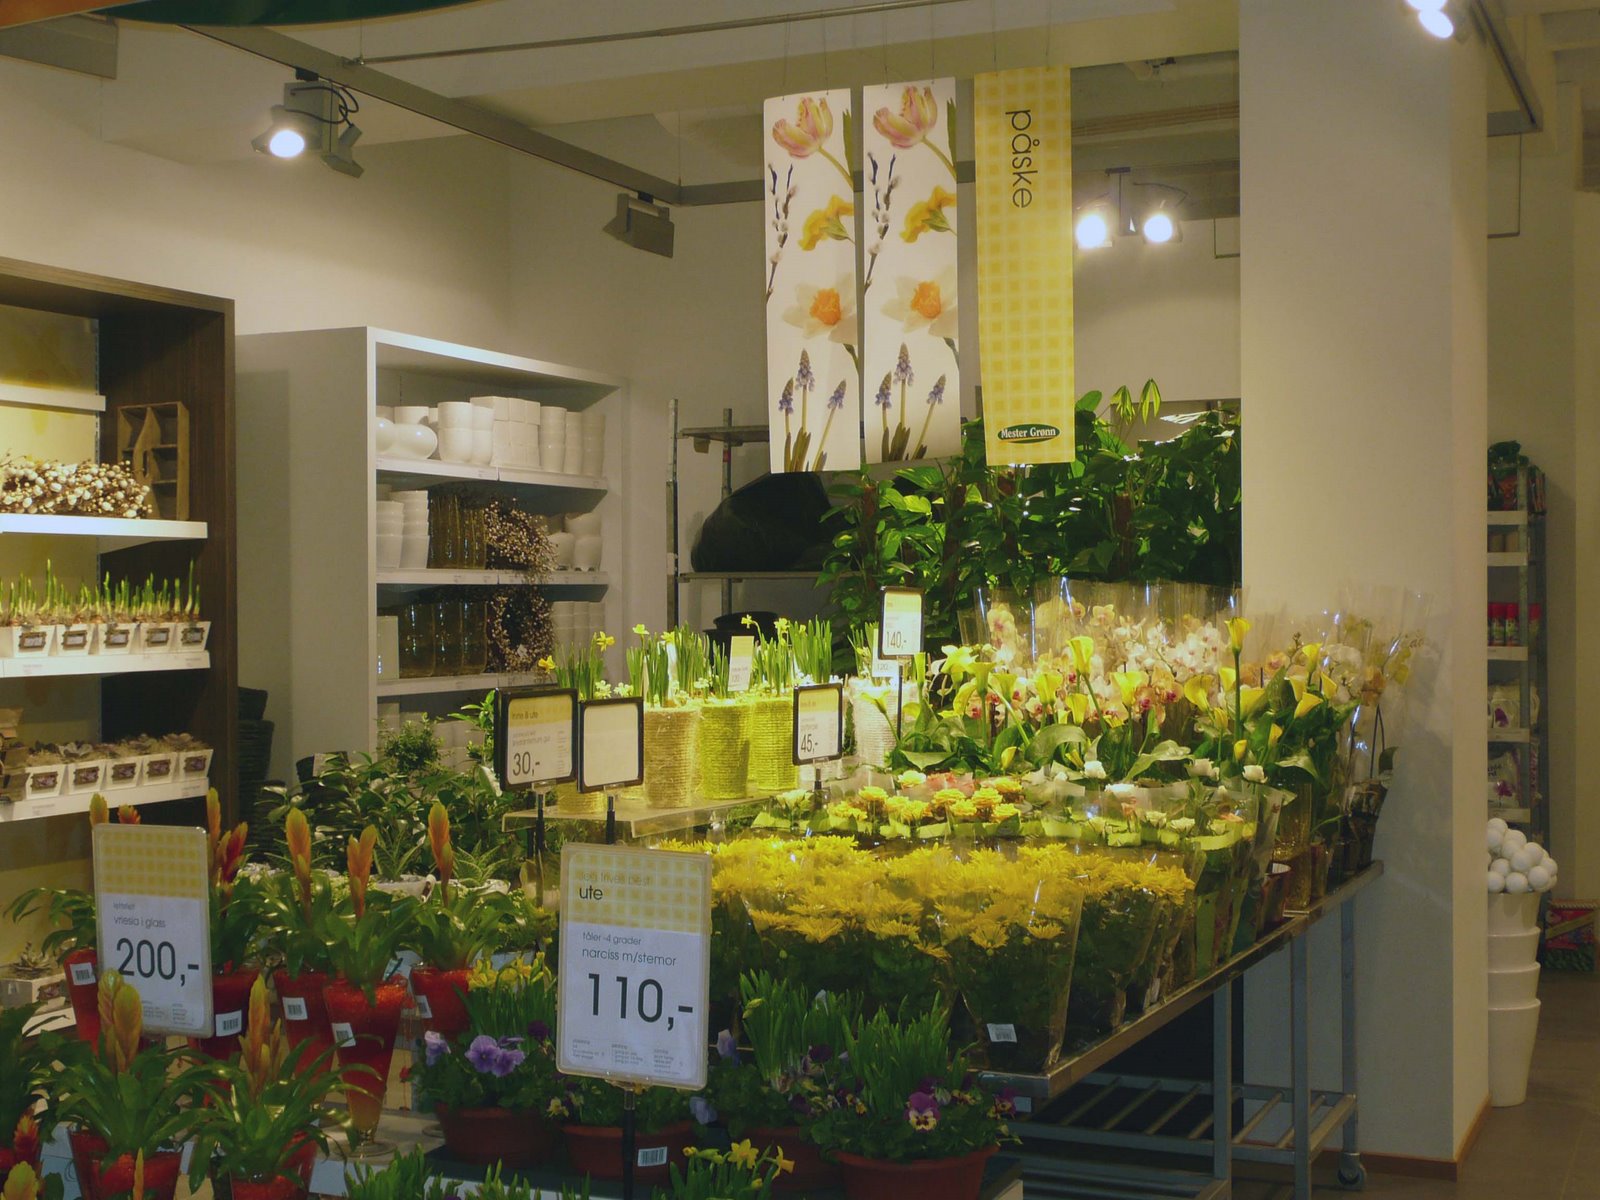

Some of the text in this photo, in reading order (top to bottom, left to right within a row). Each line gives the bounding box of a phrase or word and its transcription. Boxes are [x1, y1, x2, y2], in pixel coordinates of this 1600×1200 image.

[1005, 109, 1040, 208] påske
[1001, 429, 1028, 439] Mester
[886, 631, 907, 649] 140,-
[800, 734, 819, 753] 45,-
[512, 751, 540, 776] 30,-
[579, 885, 603, 901] ute
[145, 917, 166, 929] glass
[582, 931, 601, 941] tåler
[612, 936, 642, 945] grader
[116, 938, 199, 986] 200,-
[582, 948, 677, 966] narciss m/stemor
[588, 973, 693, 1031] 110,-
